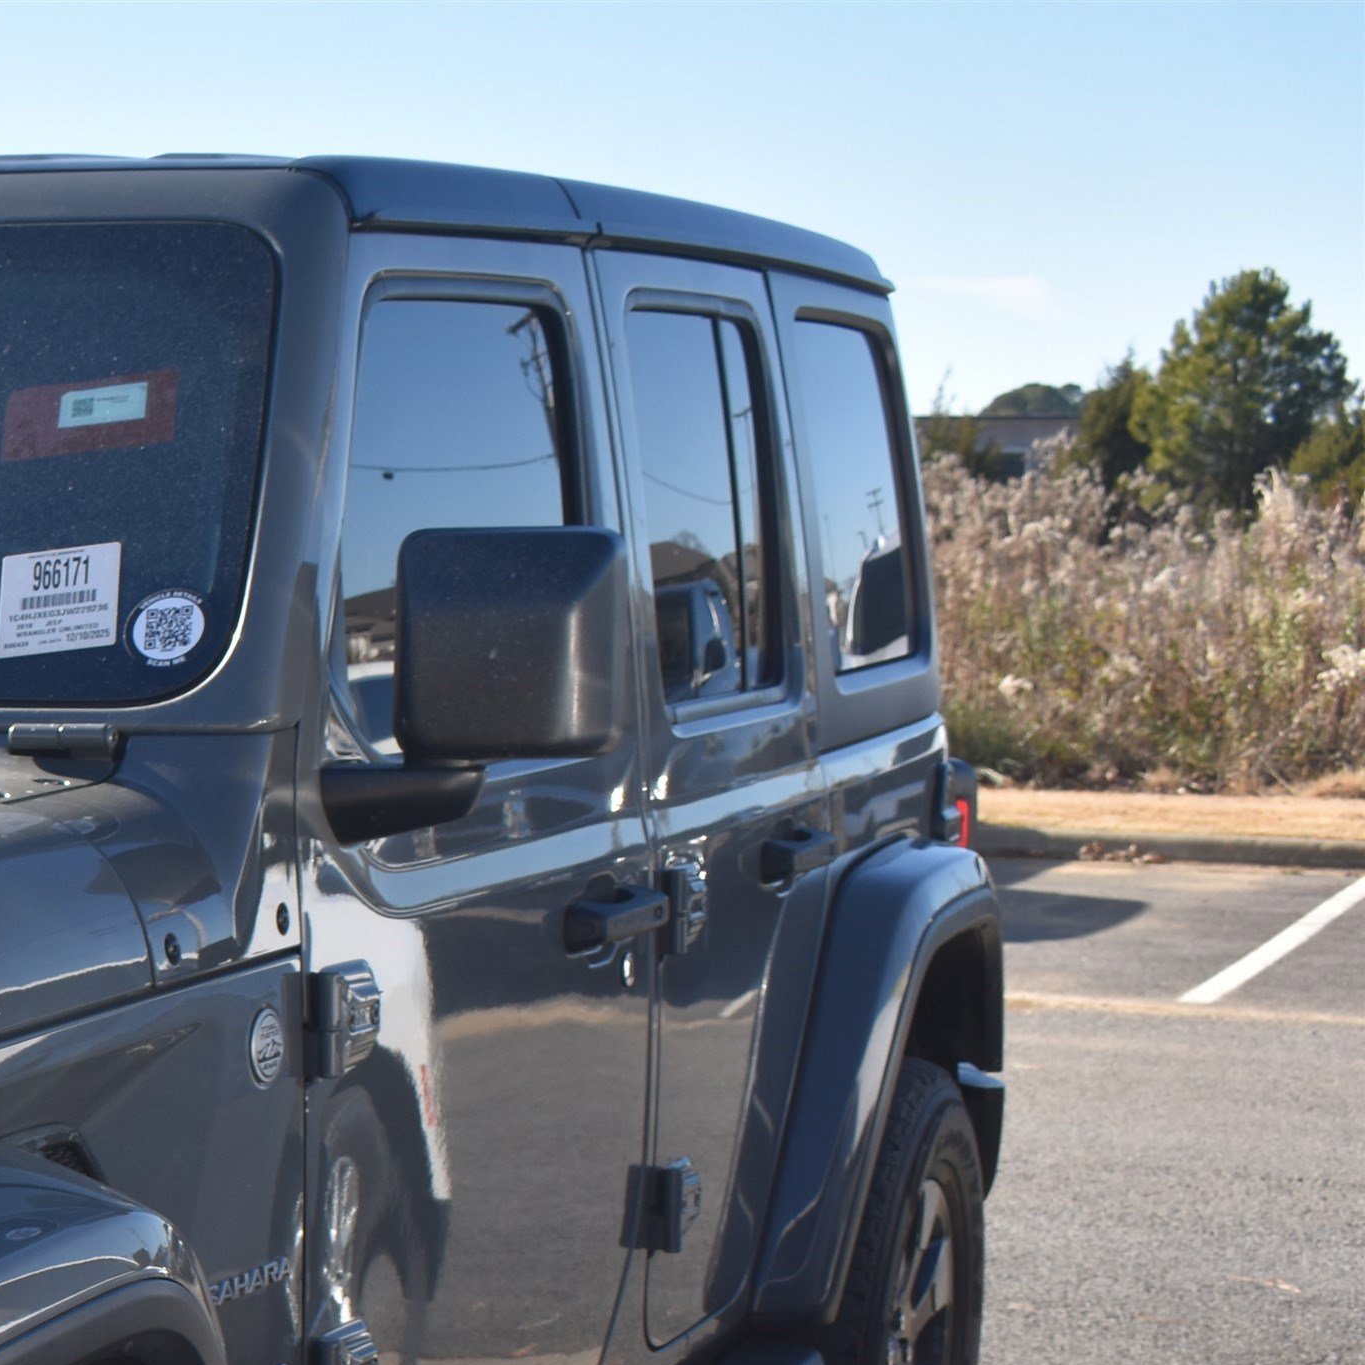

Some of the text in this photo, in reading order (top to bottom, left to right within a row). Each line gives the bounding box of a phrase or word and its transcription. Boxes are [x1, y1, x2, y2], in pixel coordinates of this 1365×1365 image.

[32, 555, 89, 591] 966171
[139, 591, 203, 609] VEHICLE DETAILS
[16, 622, 100, 638] WRANGLER UNLIMITED
[45, 619, 63, 627] JEEP
[146, 655, 186, 667] SCAN ME
[208, 1256, 293, 1306] SAHARA
